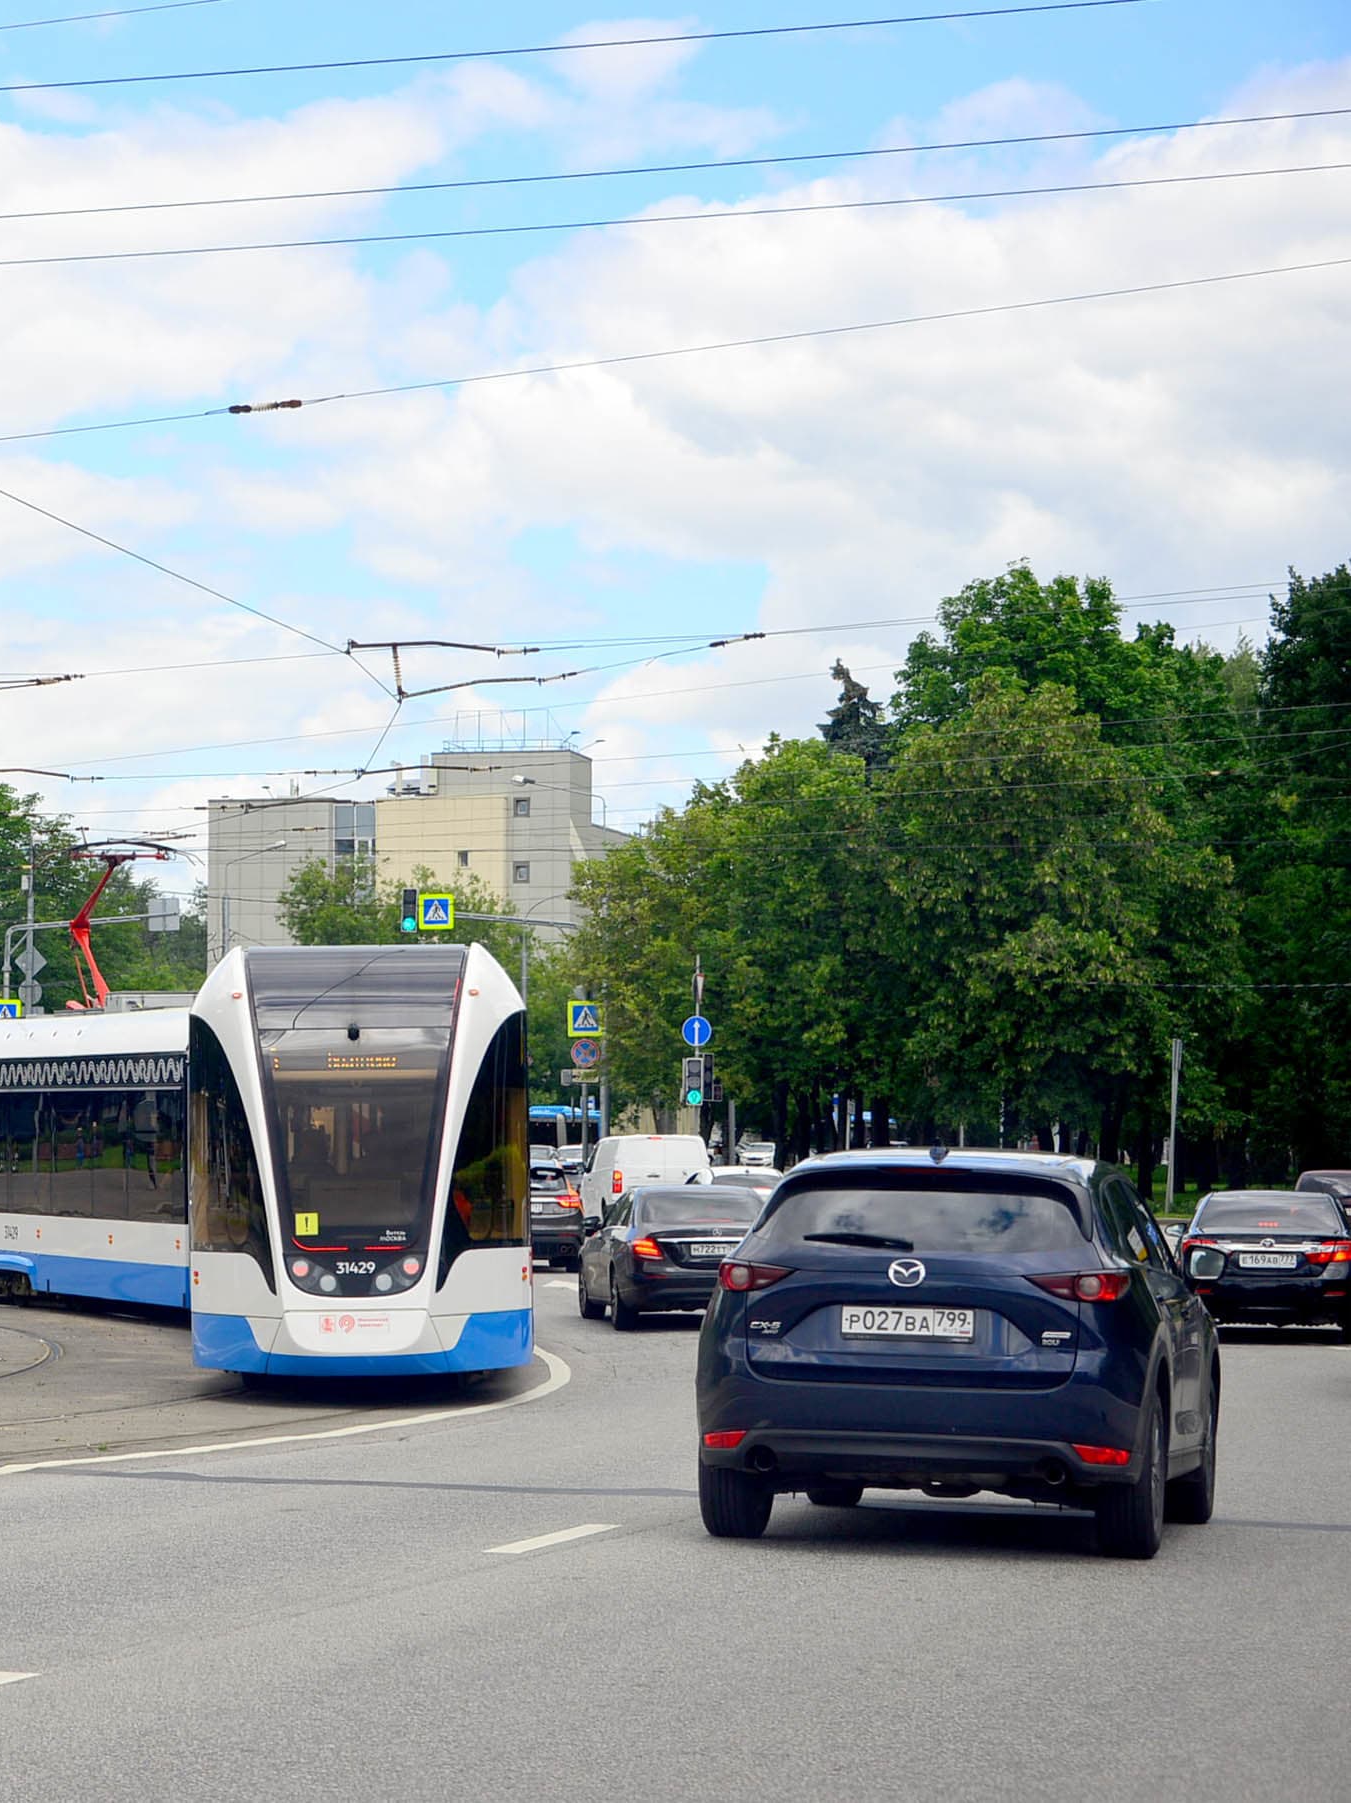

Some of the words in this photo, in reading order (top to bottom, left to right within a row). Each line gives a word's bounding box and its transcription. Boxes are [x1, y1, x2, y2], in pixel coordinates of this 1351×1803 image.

[336, 1261, 375, 1274] 31429
[750, 1321, 781, 1329] CX-5
[849, 1310, 930, 1332] Р027ВА
[936, 1311, 967, 1327] 799
